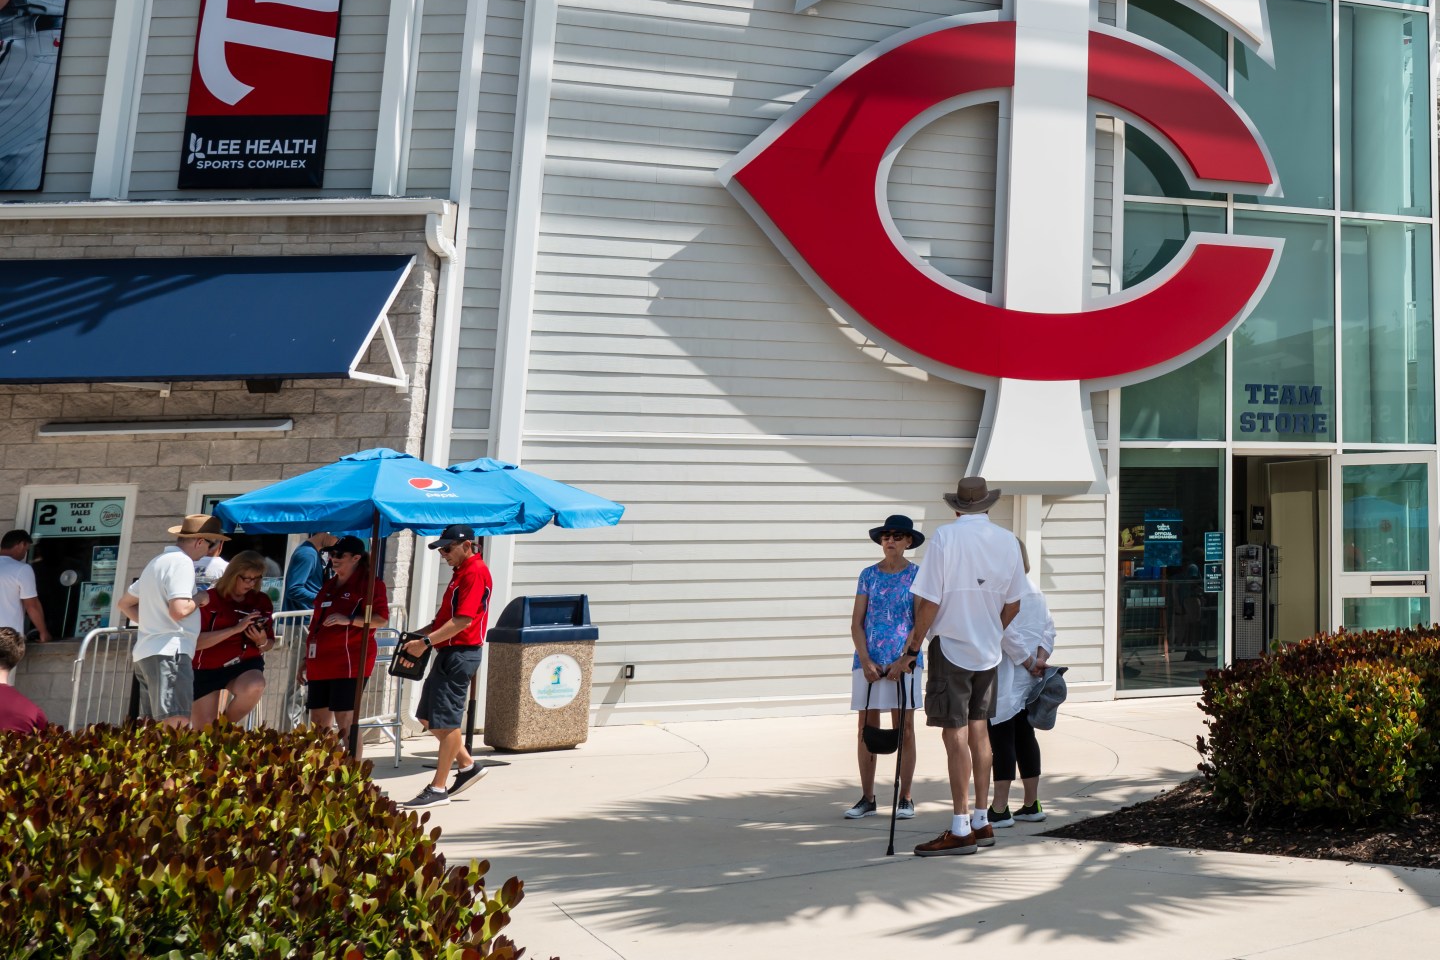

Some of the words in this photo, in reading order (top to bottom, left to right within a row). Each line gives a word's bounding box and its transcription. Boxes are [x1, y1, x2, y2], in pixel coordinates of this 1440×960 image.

[207, 139, 241, 155] LEE
[245, 139, 317, 154] HEALTH
[196, 160, 244, 169] SPORTS
[248, 160, 306, 169] COMPLEX
[1244, 383, 1323, 406] TEAM
[1240, 411, 1328, 433] STORE
[38, 504, 58, 526] 2
